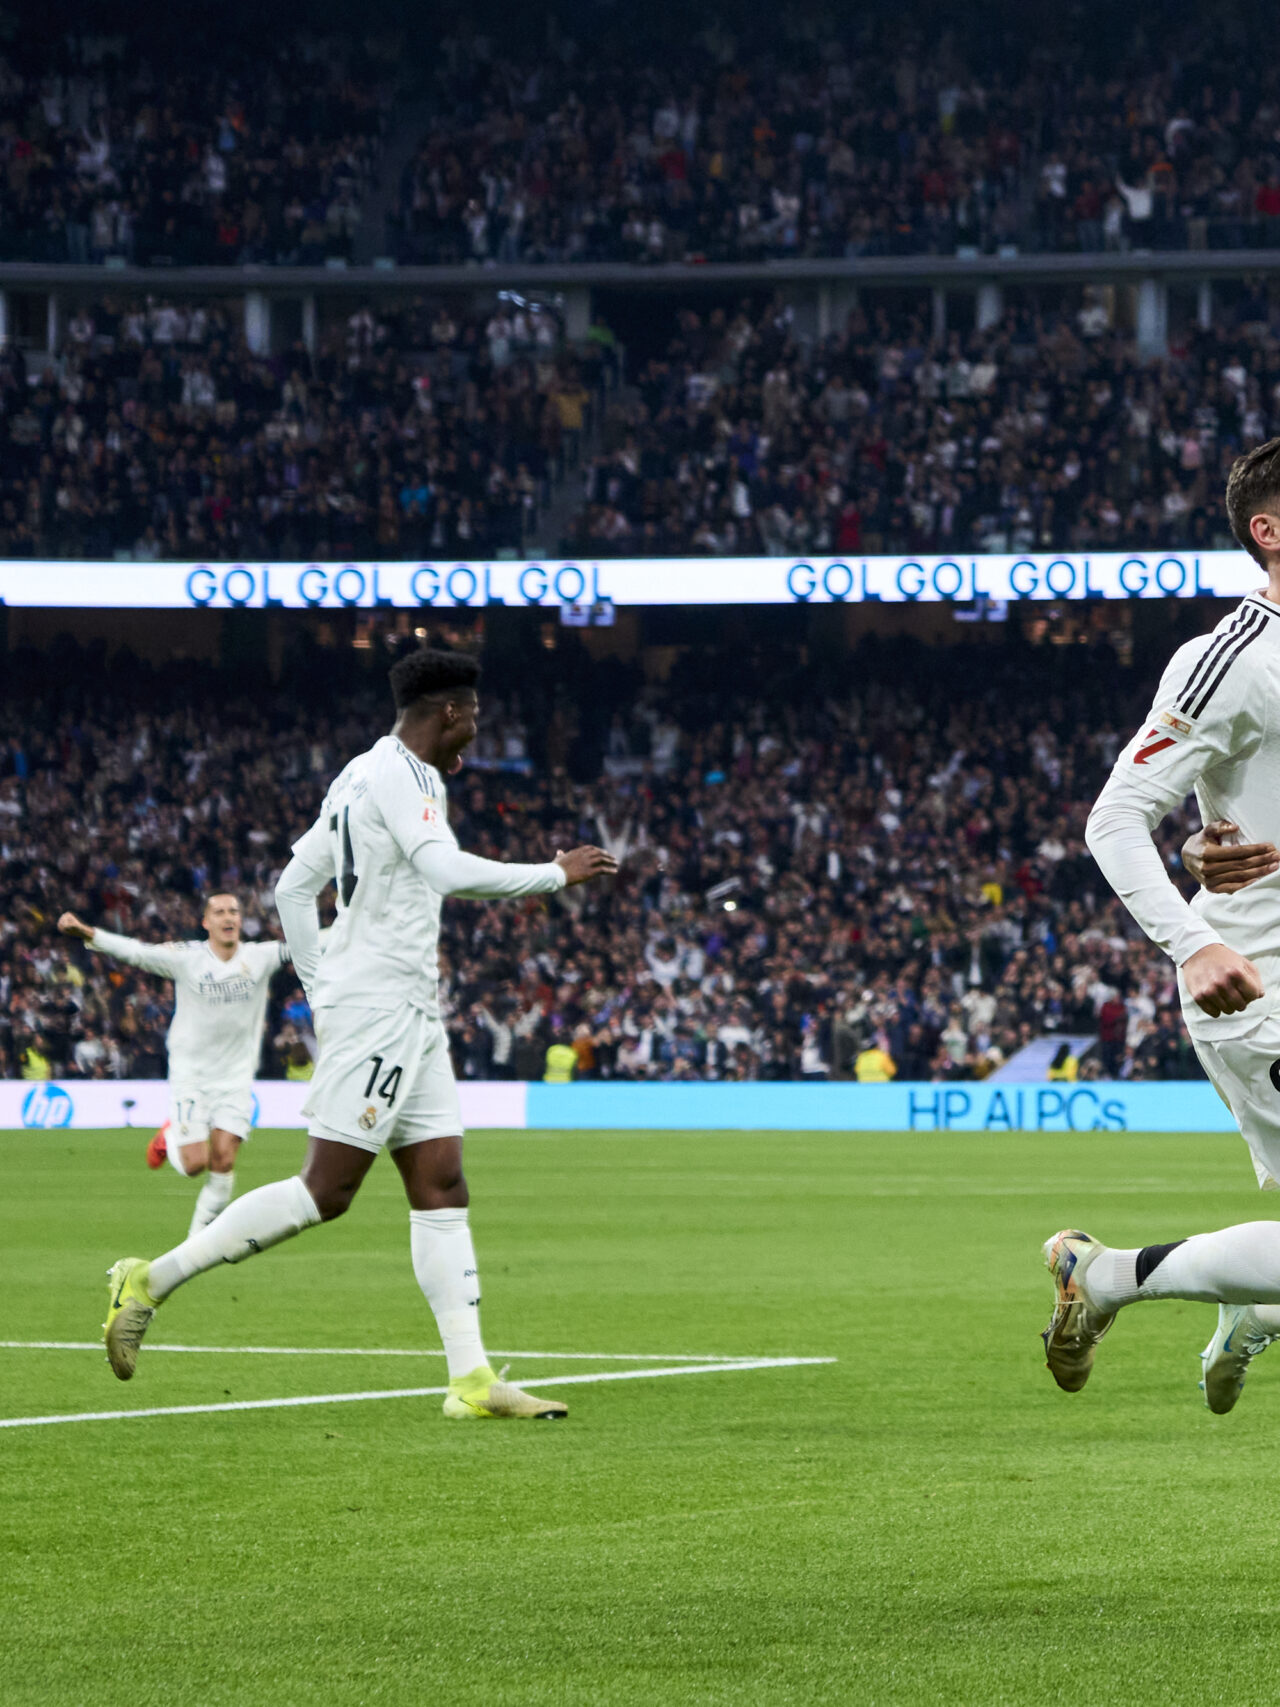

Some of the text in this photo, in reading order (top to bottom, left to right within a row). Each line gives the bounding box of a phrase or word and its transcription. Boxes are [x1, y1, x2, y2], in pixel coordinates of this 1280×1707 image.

[185, 566, 612, 607] GOL GOL GOL GOL
[787, 558, 1215, 602] GOL GOL GOL GOL
[363, 1055, 403, 1108] 14
[23, 1083, 74, 1128] hp
[177, 1100, 195, 1121] 17
[909, 1089, 1127, 1131] HP AI PCs
